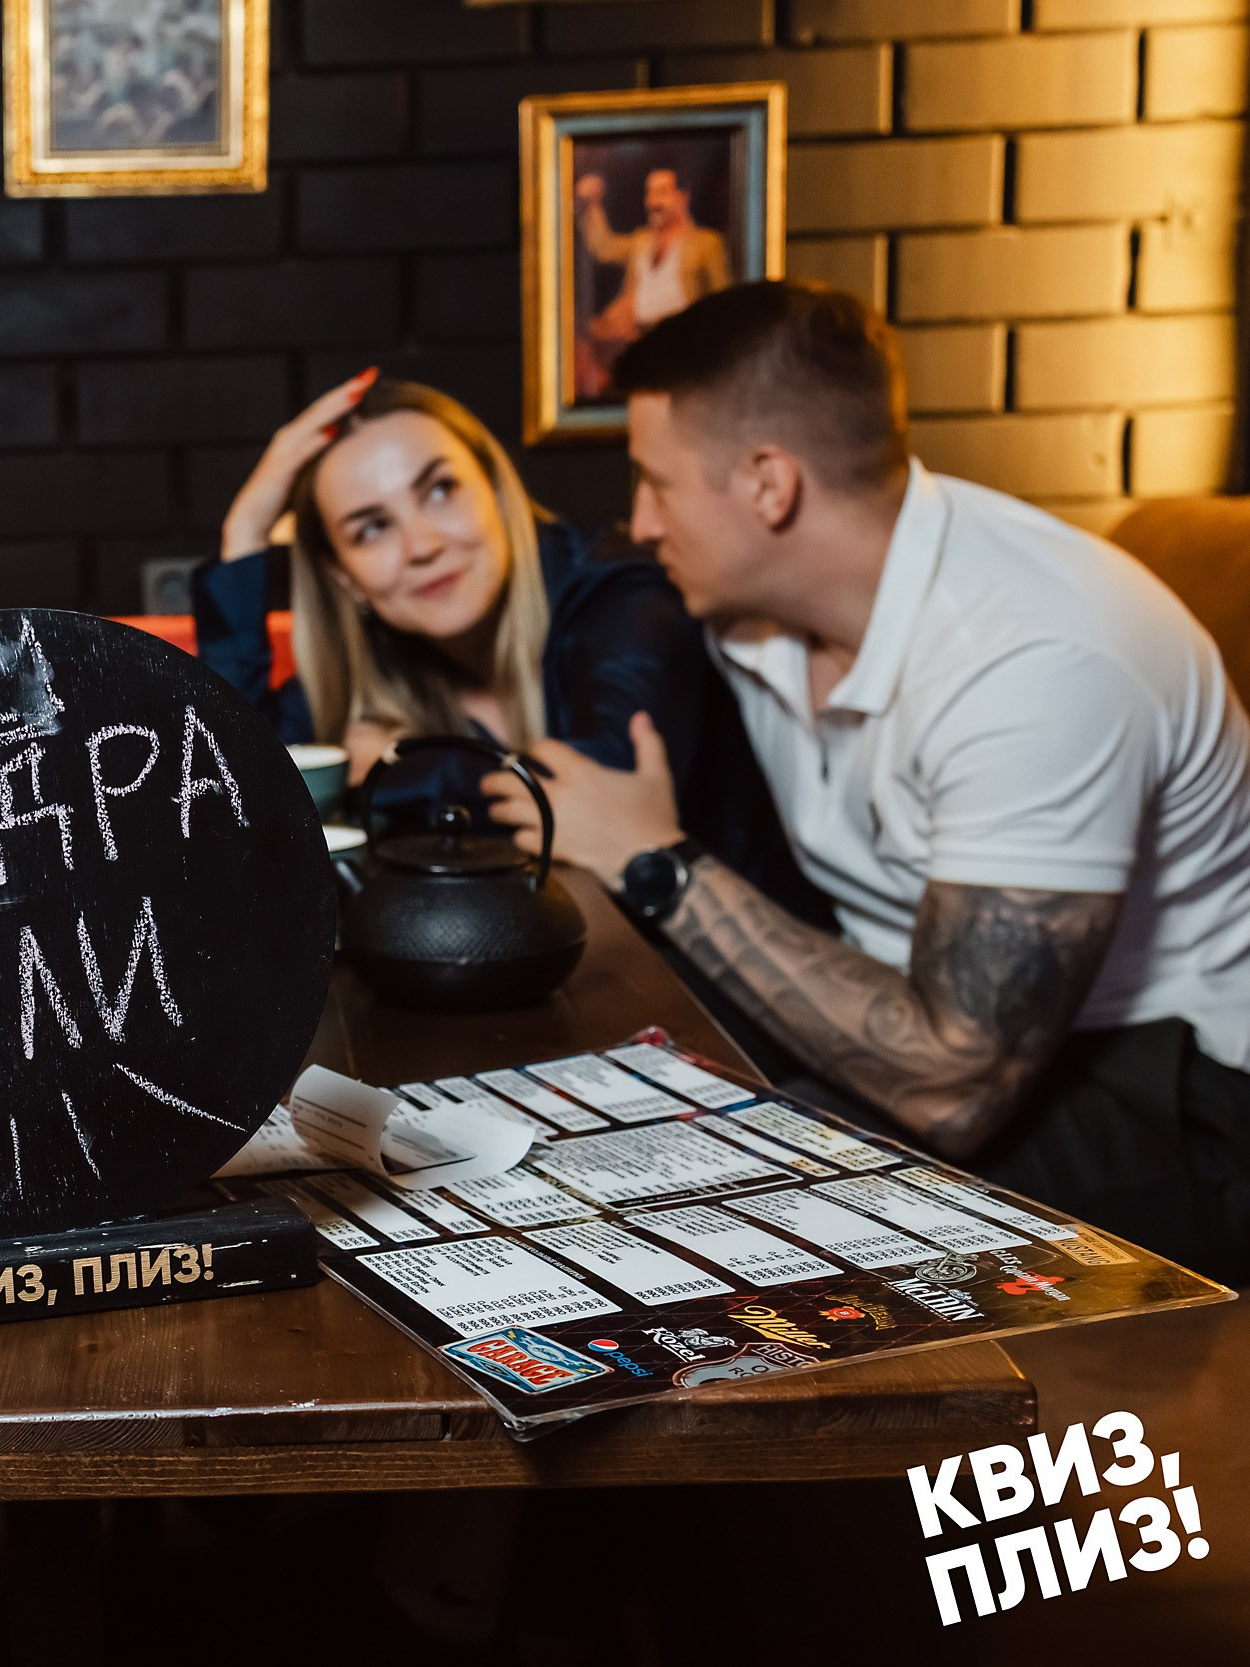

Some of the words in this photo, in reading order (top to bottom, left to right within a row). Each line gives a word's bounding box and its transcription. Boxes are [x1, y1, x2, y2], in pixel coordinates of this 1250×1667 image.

[73, 1242, 216, 1296] ПЛИЗ!
[642, 1325, 705, 1362] Kozel
[727, 1305, 831, 1350] Miller
[466, 1338, 574, 1386] GARAGE
[603, 1350, 652, 1378] pepsi
